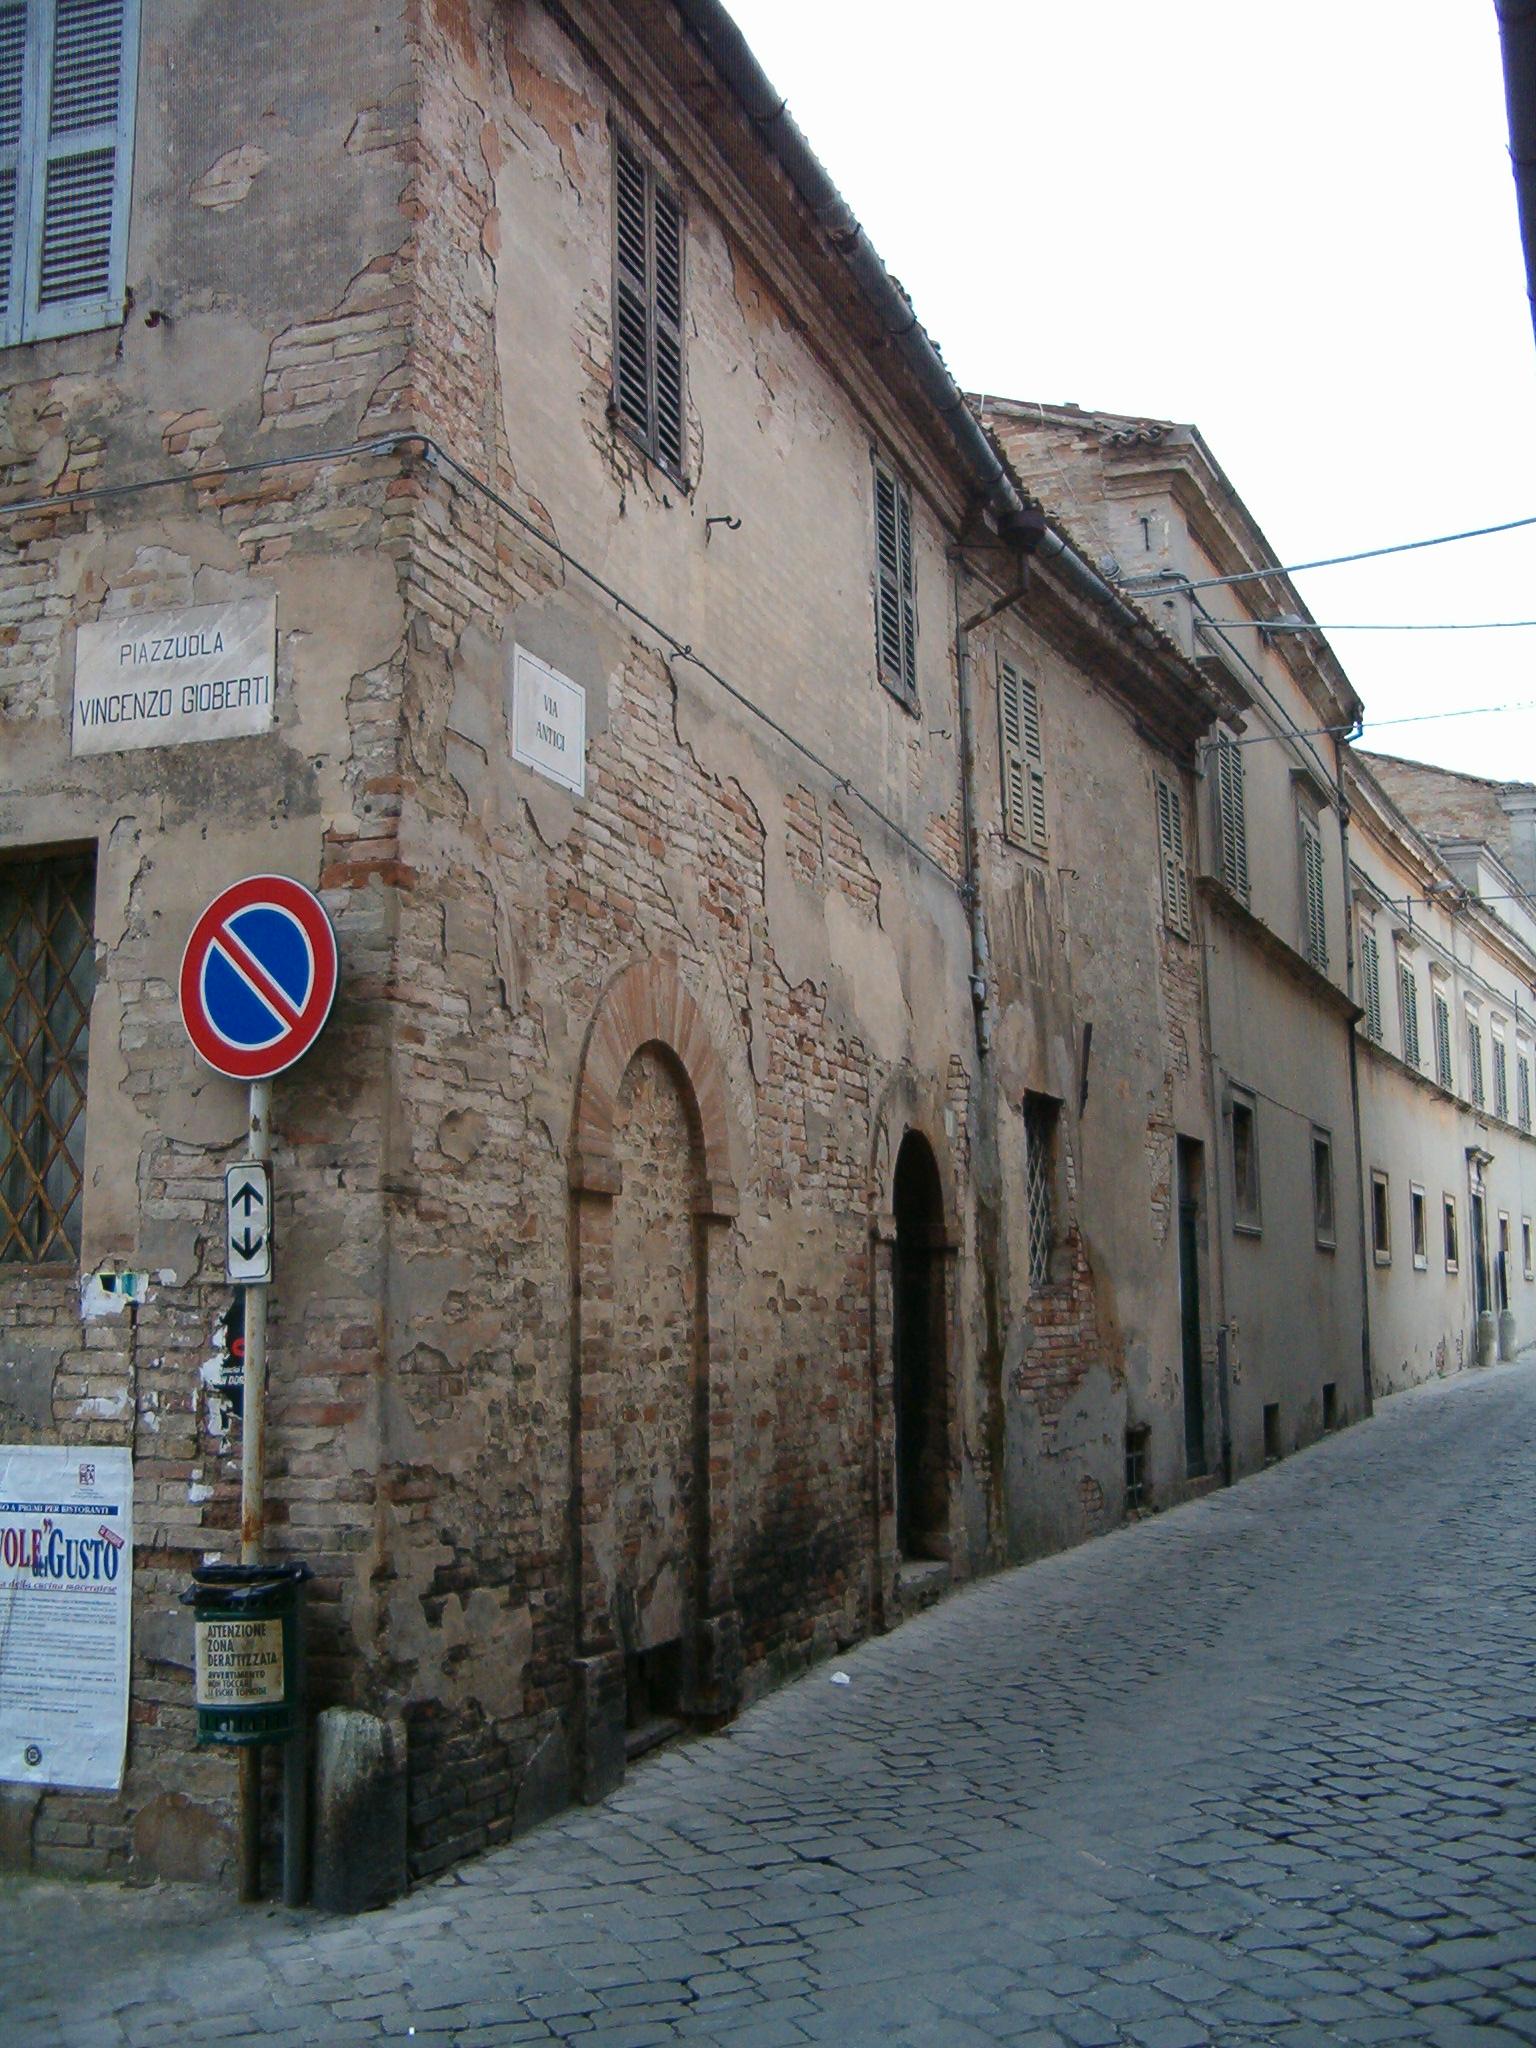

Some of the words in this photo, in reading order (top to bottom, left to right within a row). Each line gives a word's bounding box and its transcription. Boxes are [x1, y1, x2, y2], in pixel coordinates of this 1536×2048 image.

[119, 632, 224, 666] PIAZZUOLA
[79, 688, 173, 727] VINCENZO
[181, 675, 270, 715] GIOBERTI
[543, 694, 559, 719] VIA
[535, 721, 566, 752] ANTICI
[61, 1505, 109, 1515] RISTORANTI
[48, 1528, 119, 1581] GUSTO
[207, 1623, 267, 1638] ATTENZIONE
[207, 1639, 234, 1653] ZONA
[207, 1652, 278, 1668] DERATTIZZATA
